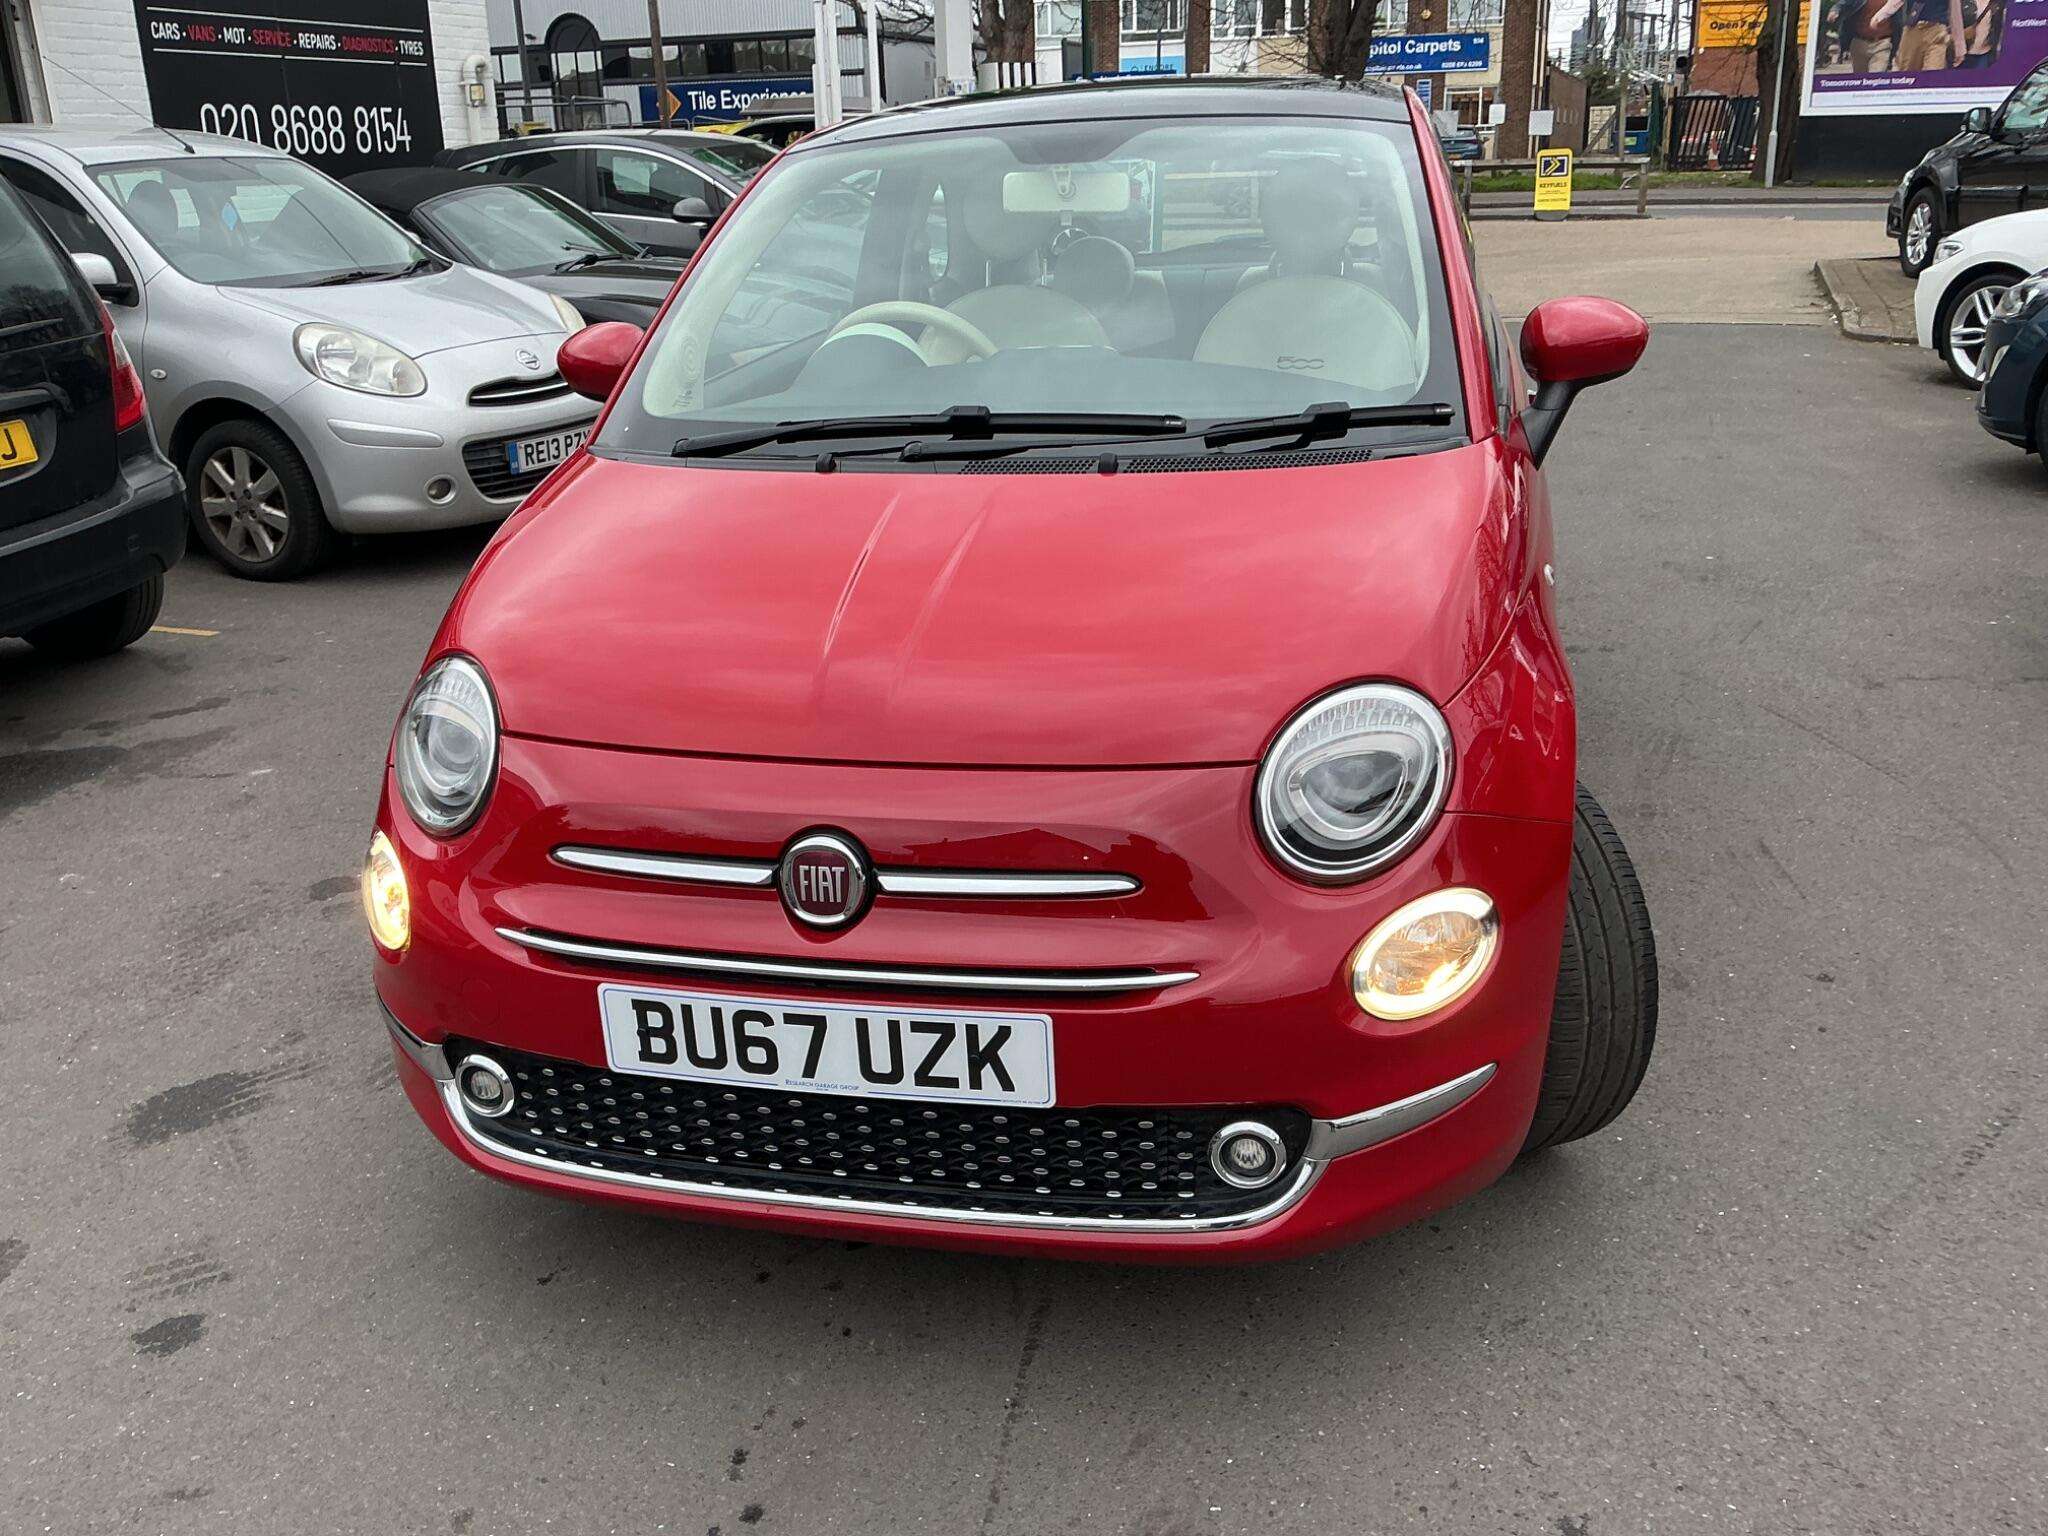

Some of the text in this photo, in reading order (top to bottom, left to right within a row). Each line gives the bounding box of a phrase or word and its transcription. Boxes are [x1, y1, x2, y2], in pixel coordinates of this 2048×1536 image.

[150, 21, 424, 56] CARS VANS MOT SERVICE REPAIRS DIAGNOSTICS TYRES
[1710, 20, 1738, 31] Open
[1404, 38, 1462, 55] Carpets
[1820, 79, 1861, 88] Tomorrow
[1891, 76, 1916, 85] today
[687, 90, 717, 111] Tile
[200, 103, 412, 155] 020 8688 8154
[523, 438, 561, 466] RE13
[798, 865, 845, 903] FIAT
[631, 998, 1016, 1093] BU67 UZK
